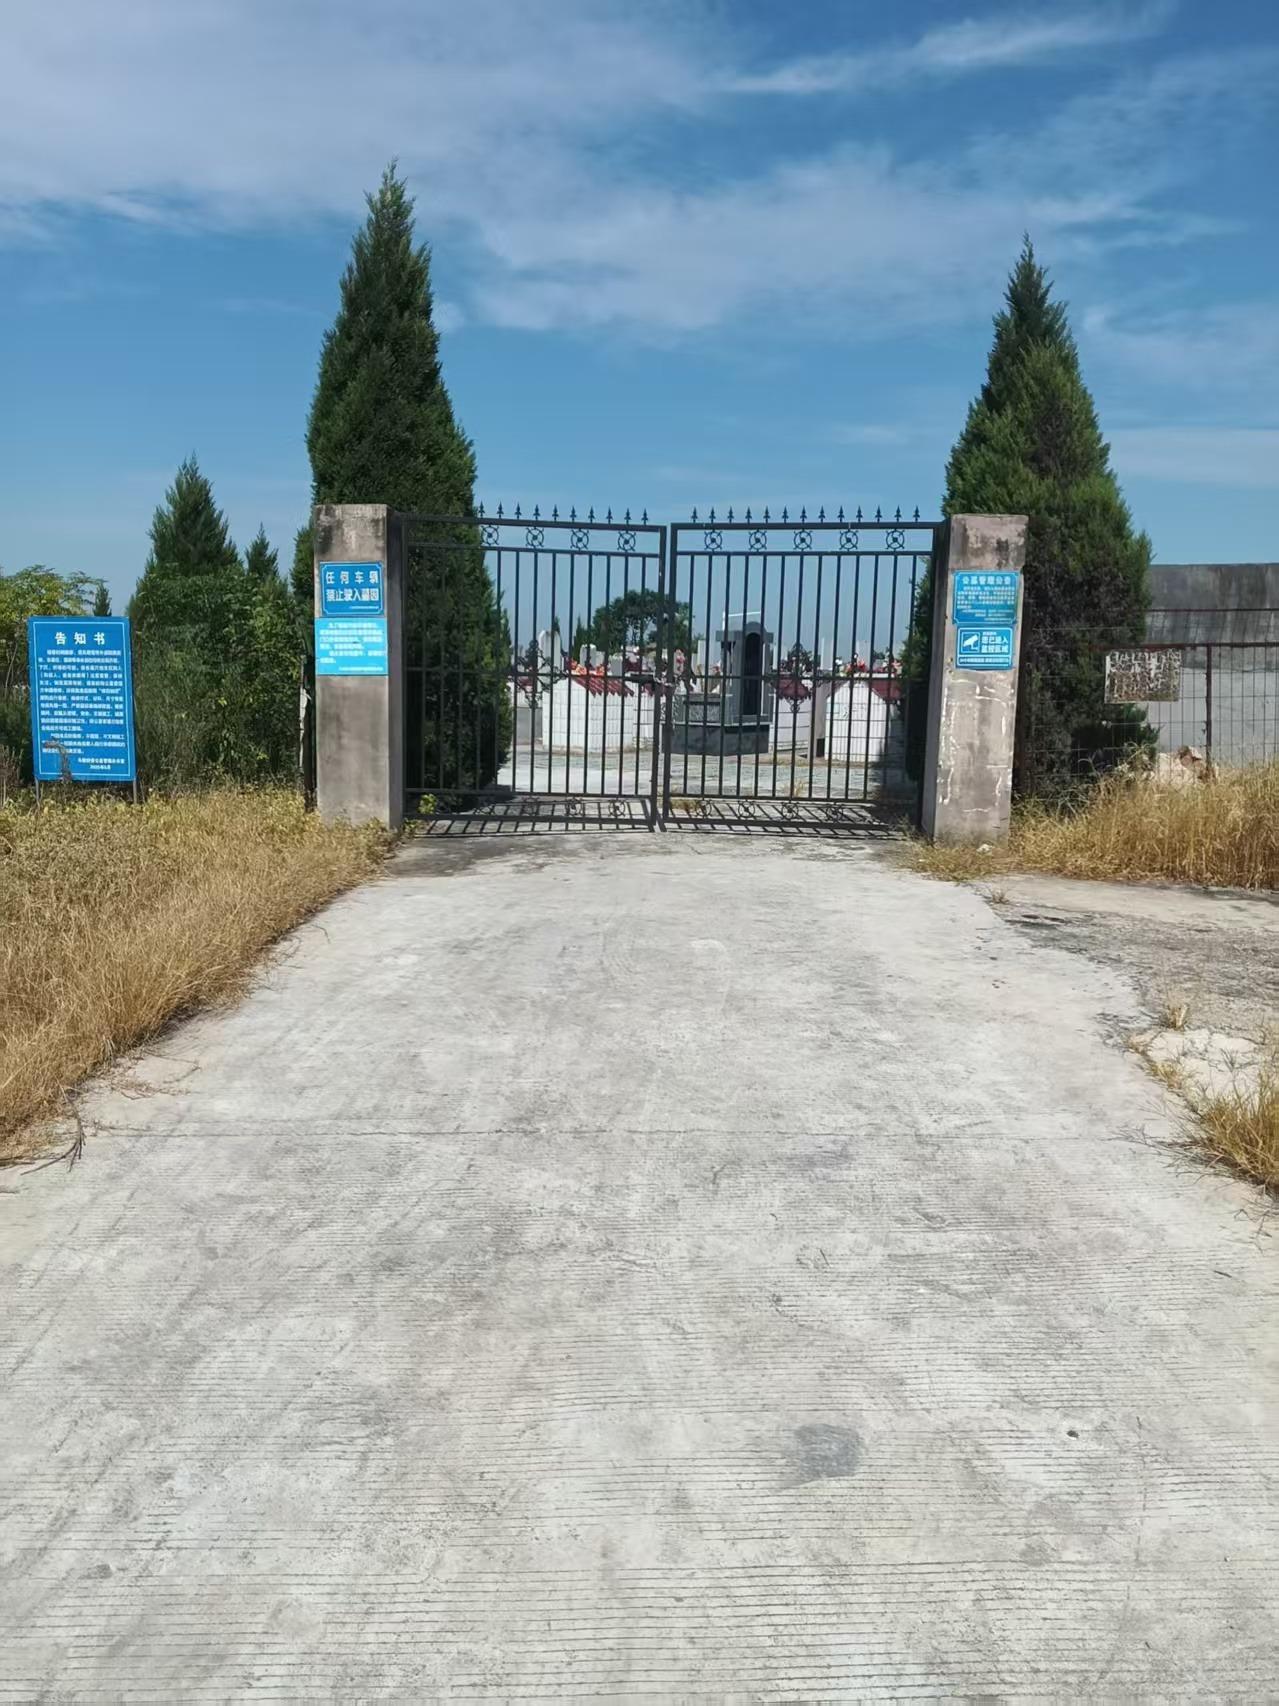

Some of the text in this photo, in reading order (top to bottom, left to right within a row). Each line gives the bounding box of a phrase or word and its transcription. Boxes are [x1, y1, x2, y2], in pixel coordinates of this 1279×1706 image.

[326, 571, 378, 584] 任何车辆
[326, 588, 379, 601] 禁止驶入墓园
[55, 632, 105, 645] 告知书
